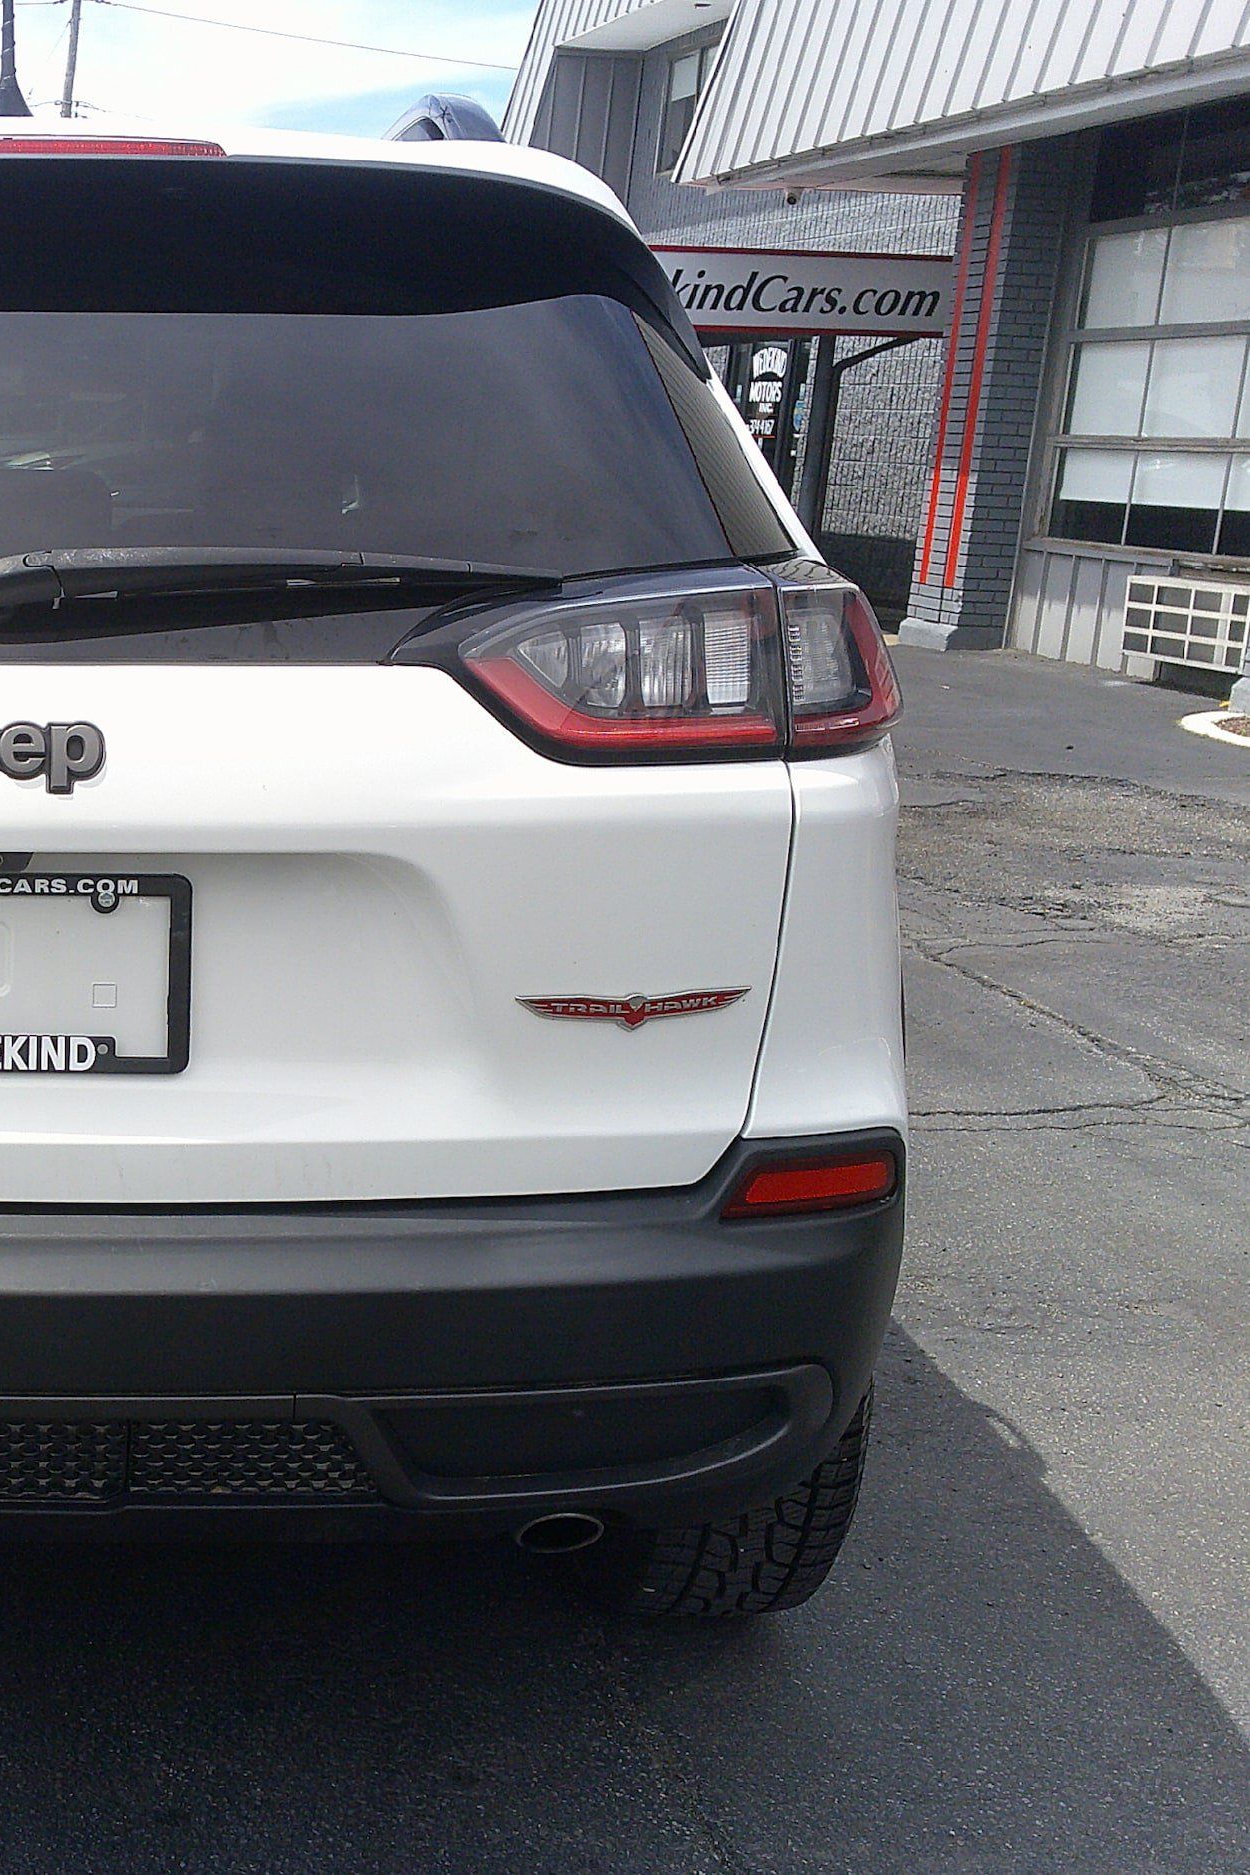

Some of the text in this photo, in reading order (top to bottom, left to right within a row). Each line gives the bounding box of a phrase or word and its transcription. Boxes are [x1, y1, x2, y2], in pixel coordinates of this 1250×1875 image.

[753, 347, 788, 380] WEDEKIND
[748, 381, 783, 403] MOTORS
[550, 995, 719, 1015] TRAIL HAWK
